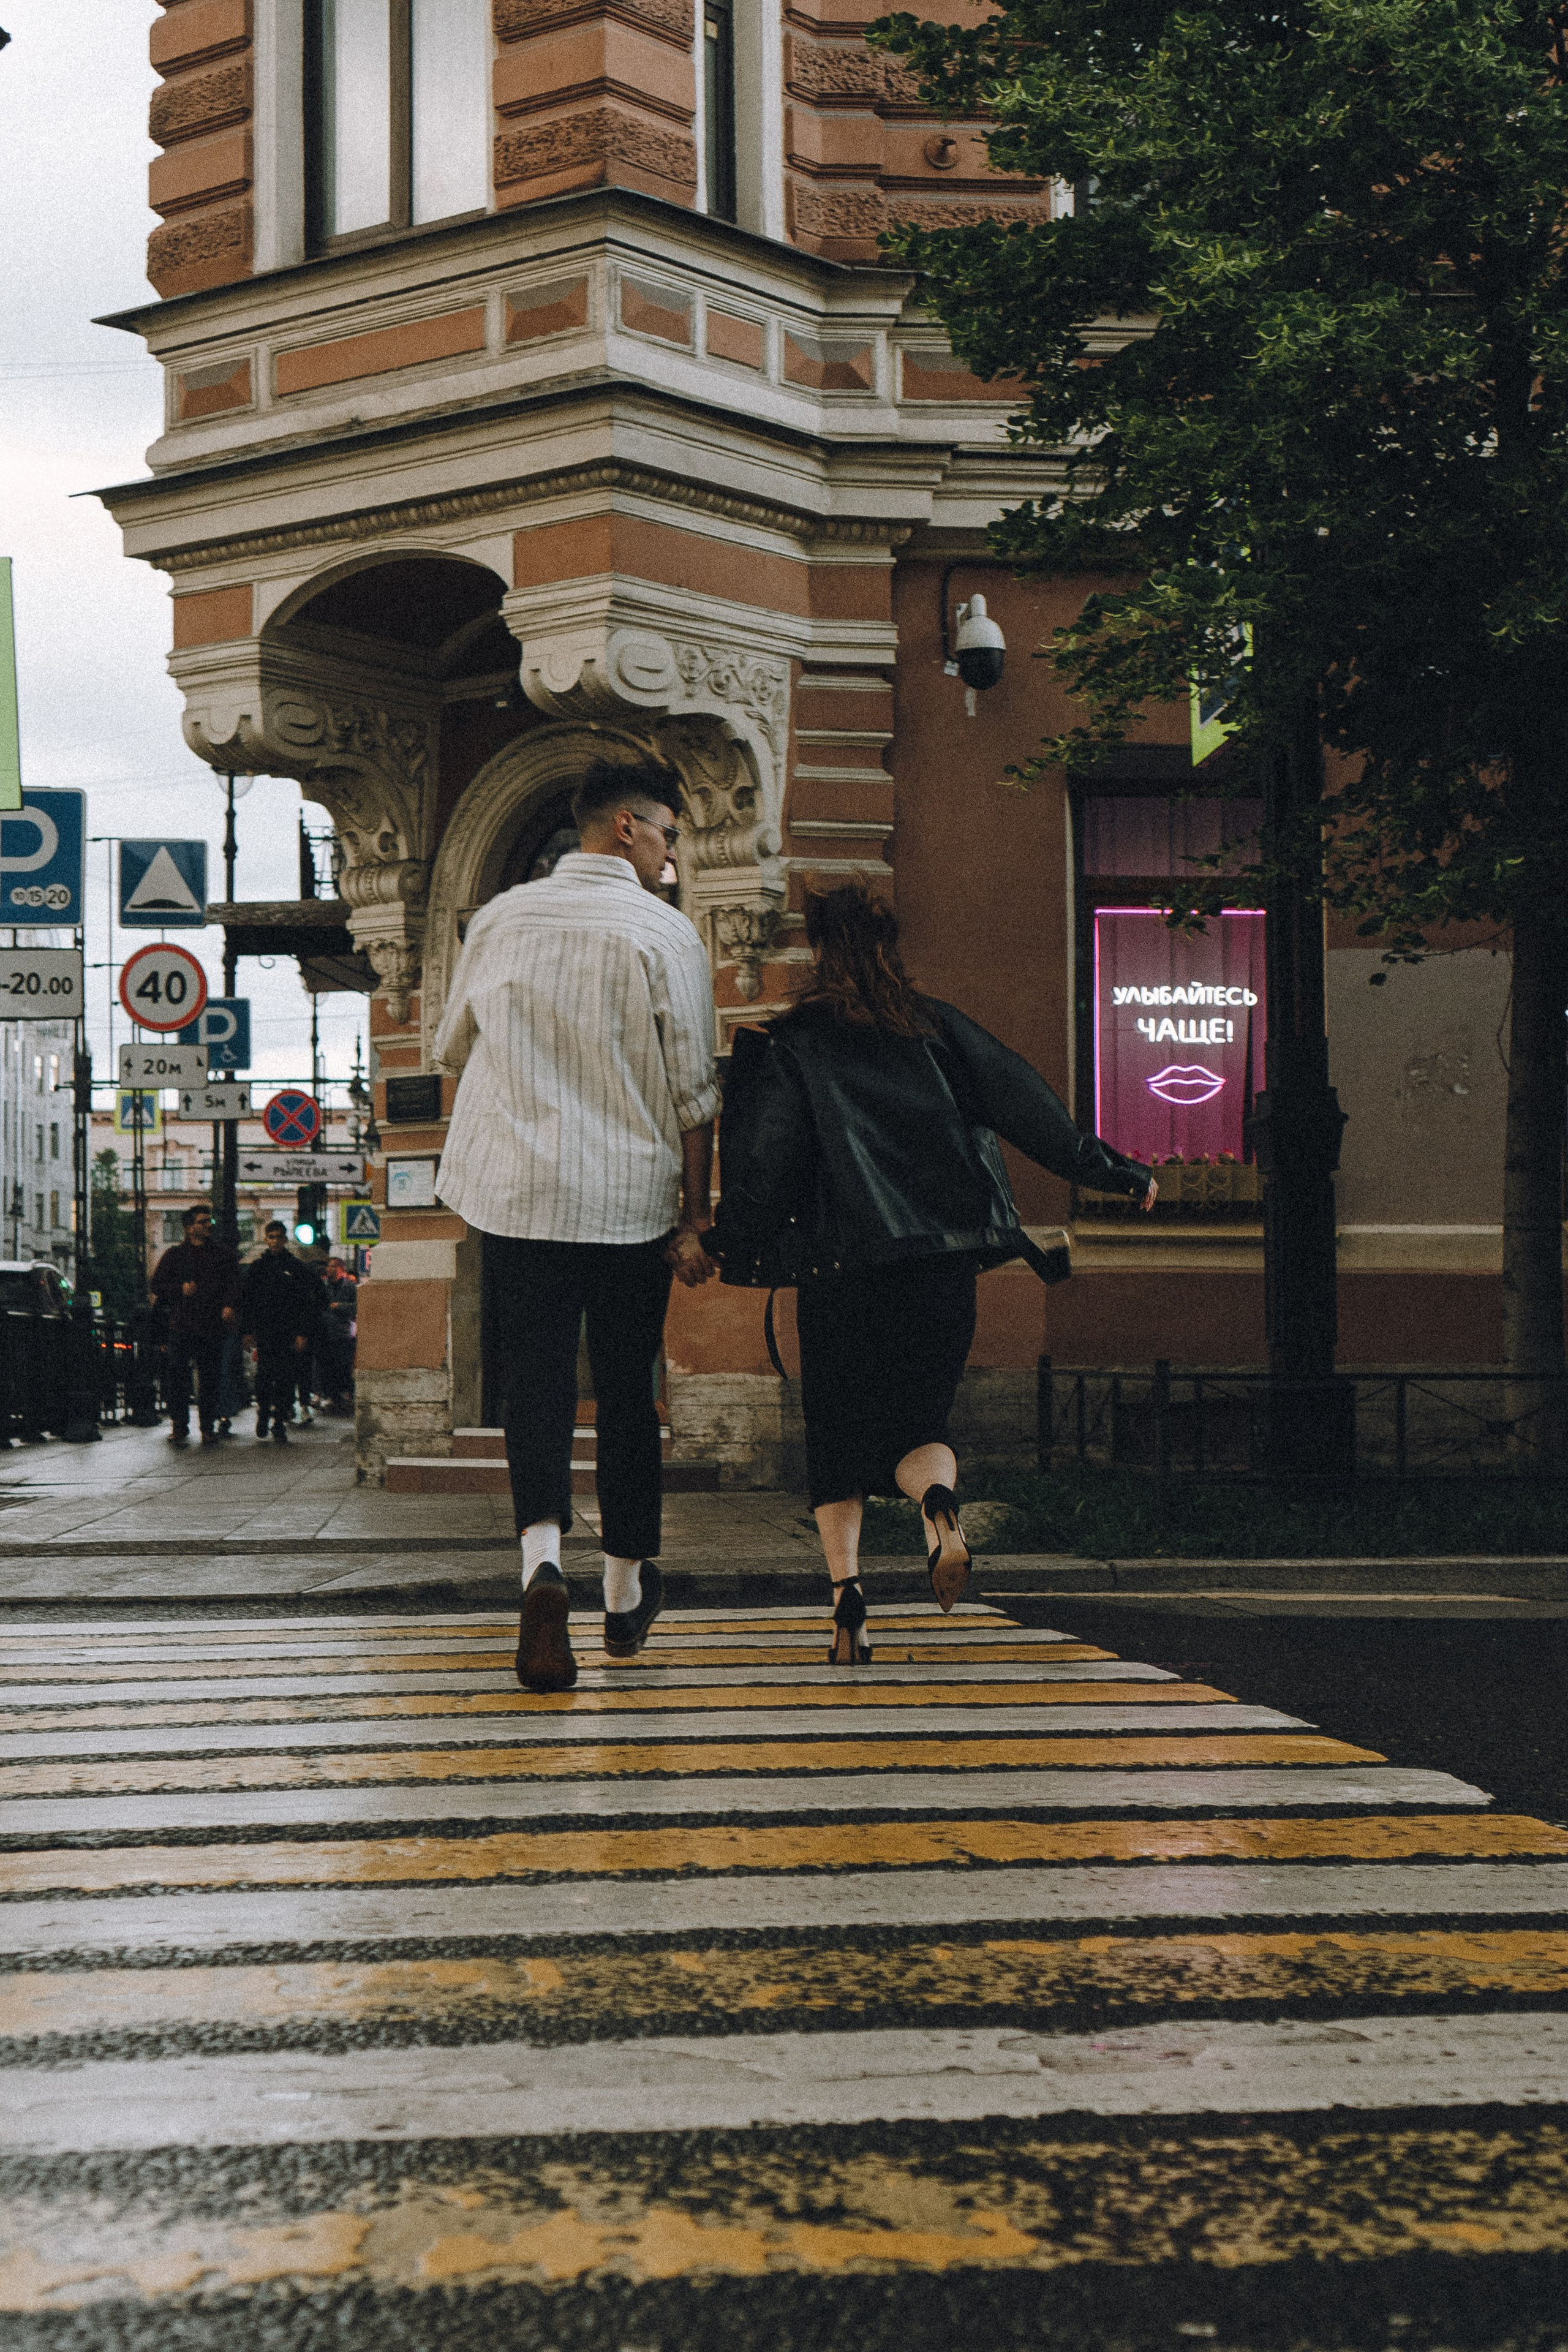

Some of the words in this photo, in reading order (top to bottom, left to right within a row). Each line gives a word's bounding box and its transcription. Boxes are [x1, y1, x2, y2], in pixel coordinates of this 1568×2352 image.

[48, 889, 68, 903] 20
[136, 970, 187, 1005] 40
[1112, 981, 1258, 1006] УЛЫБАЙТЕСЬ
[1137, 1017, 1234, 1044] ЧАЩЕ!
